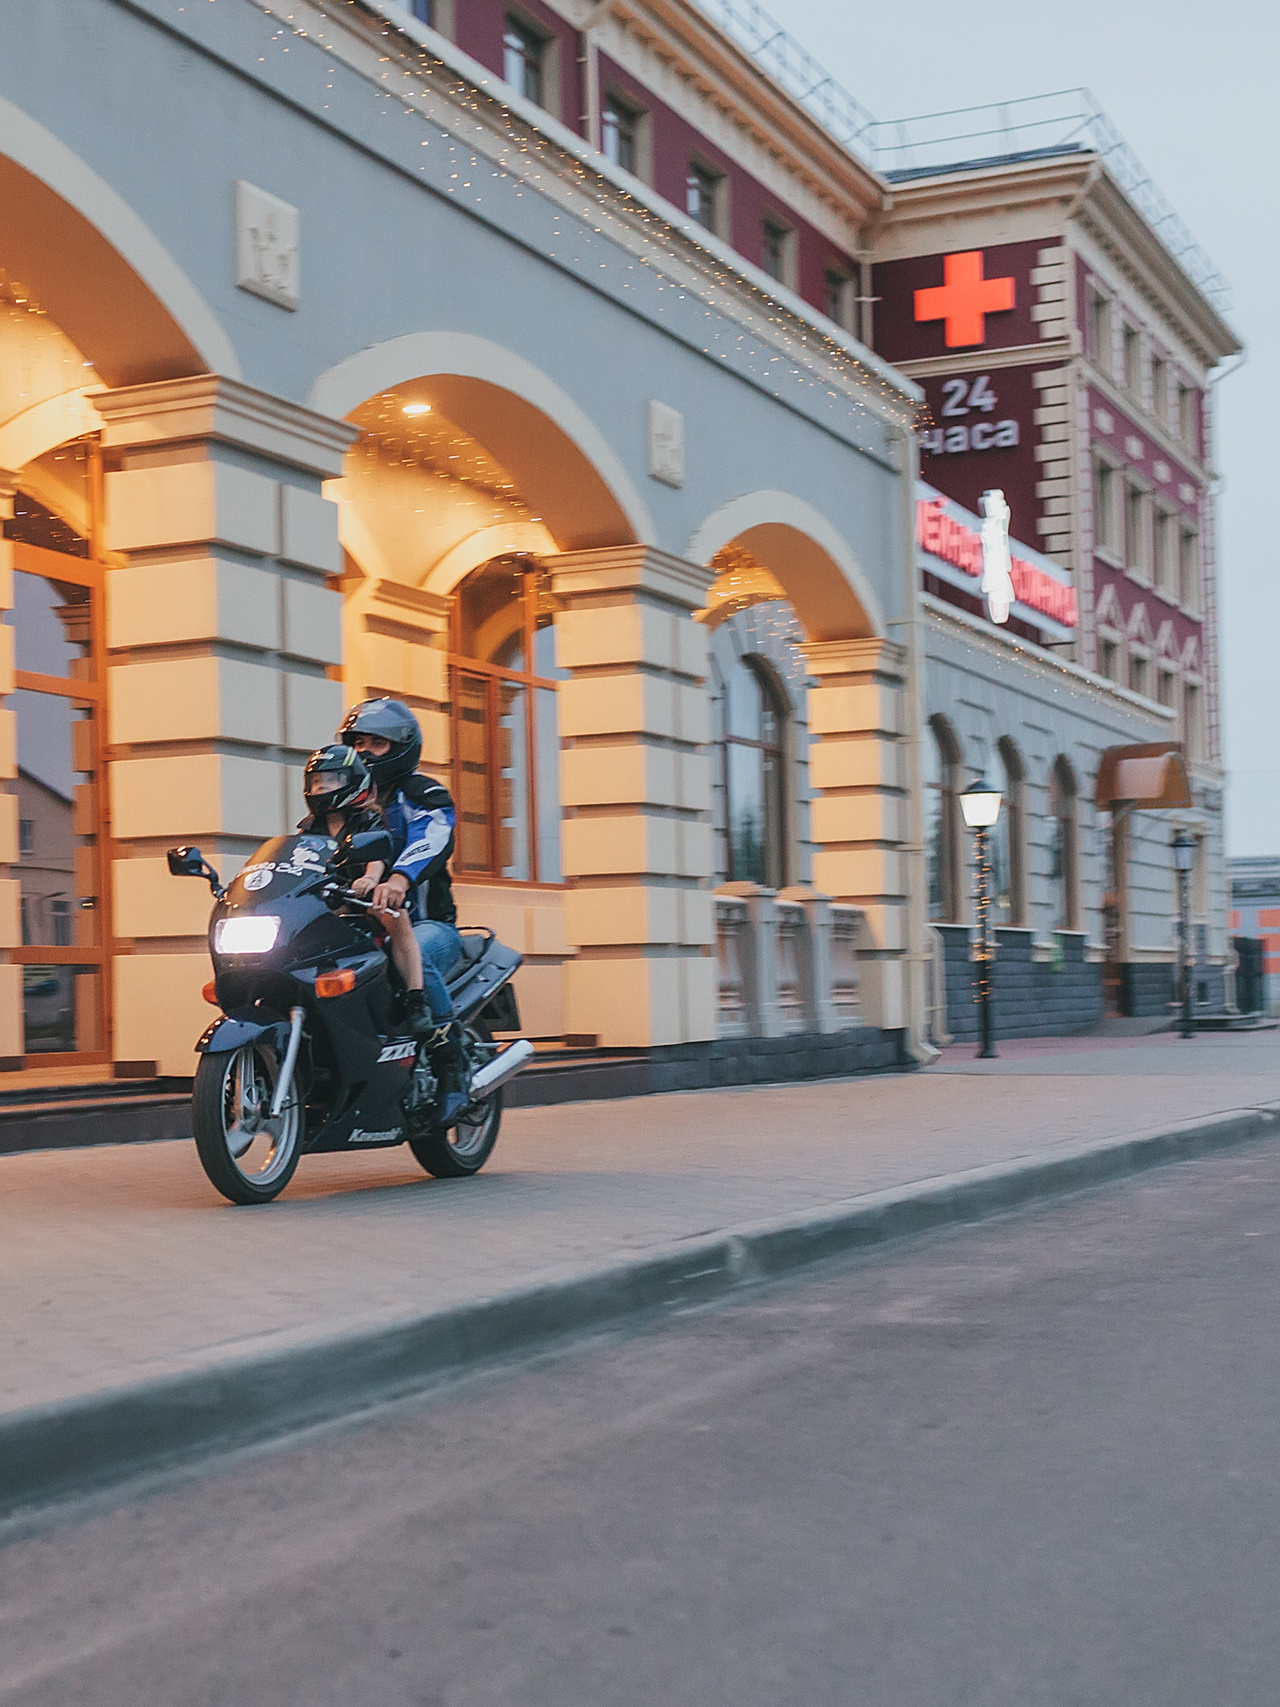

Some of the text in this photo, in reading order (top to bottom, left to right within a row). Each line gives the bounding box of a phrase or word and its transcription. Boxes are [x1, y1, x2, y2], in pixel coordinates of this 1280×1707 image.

[941, 375, 999, 417] 24
[920, 419, 1020, 455] часа
[376, 1040, 418, 1063] ZZR
